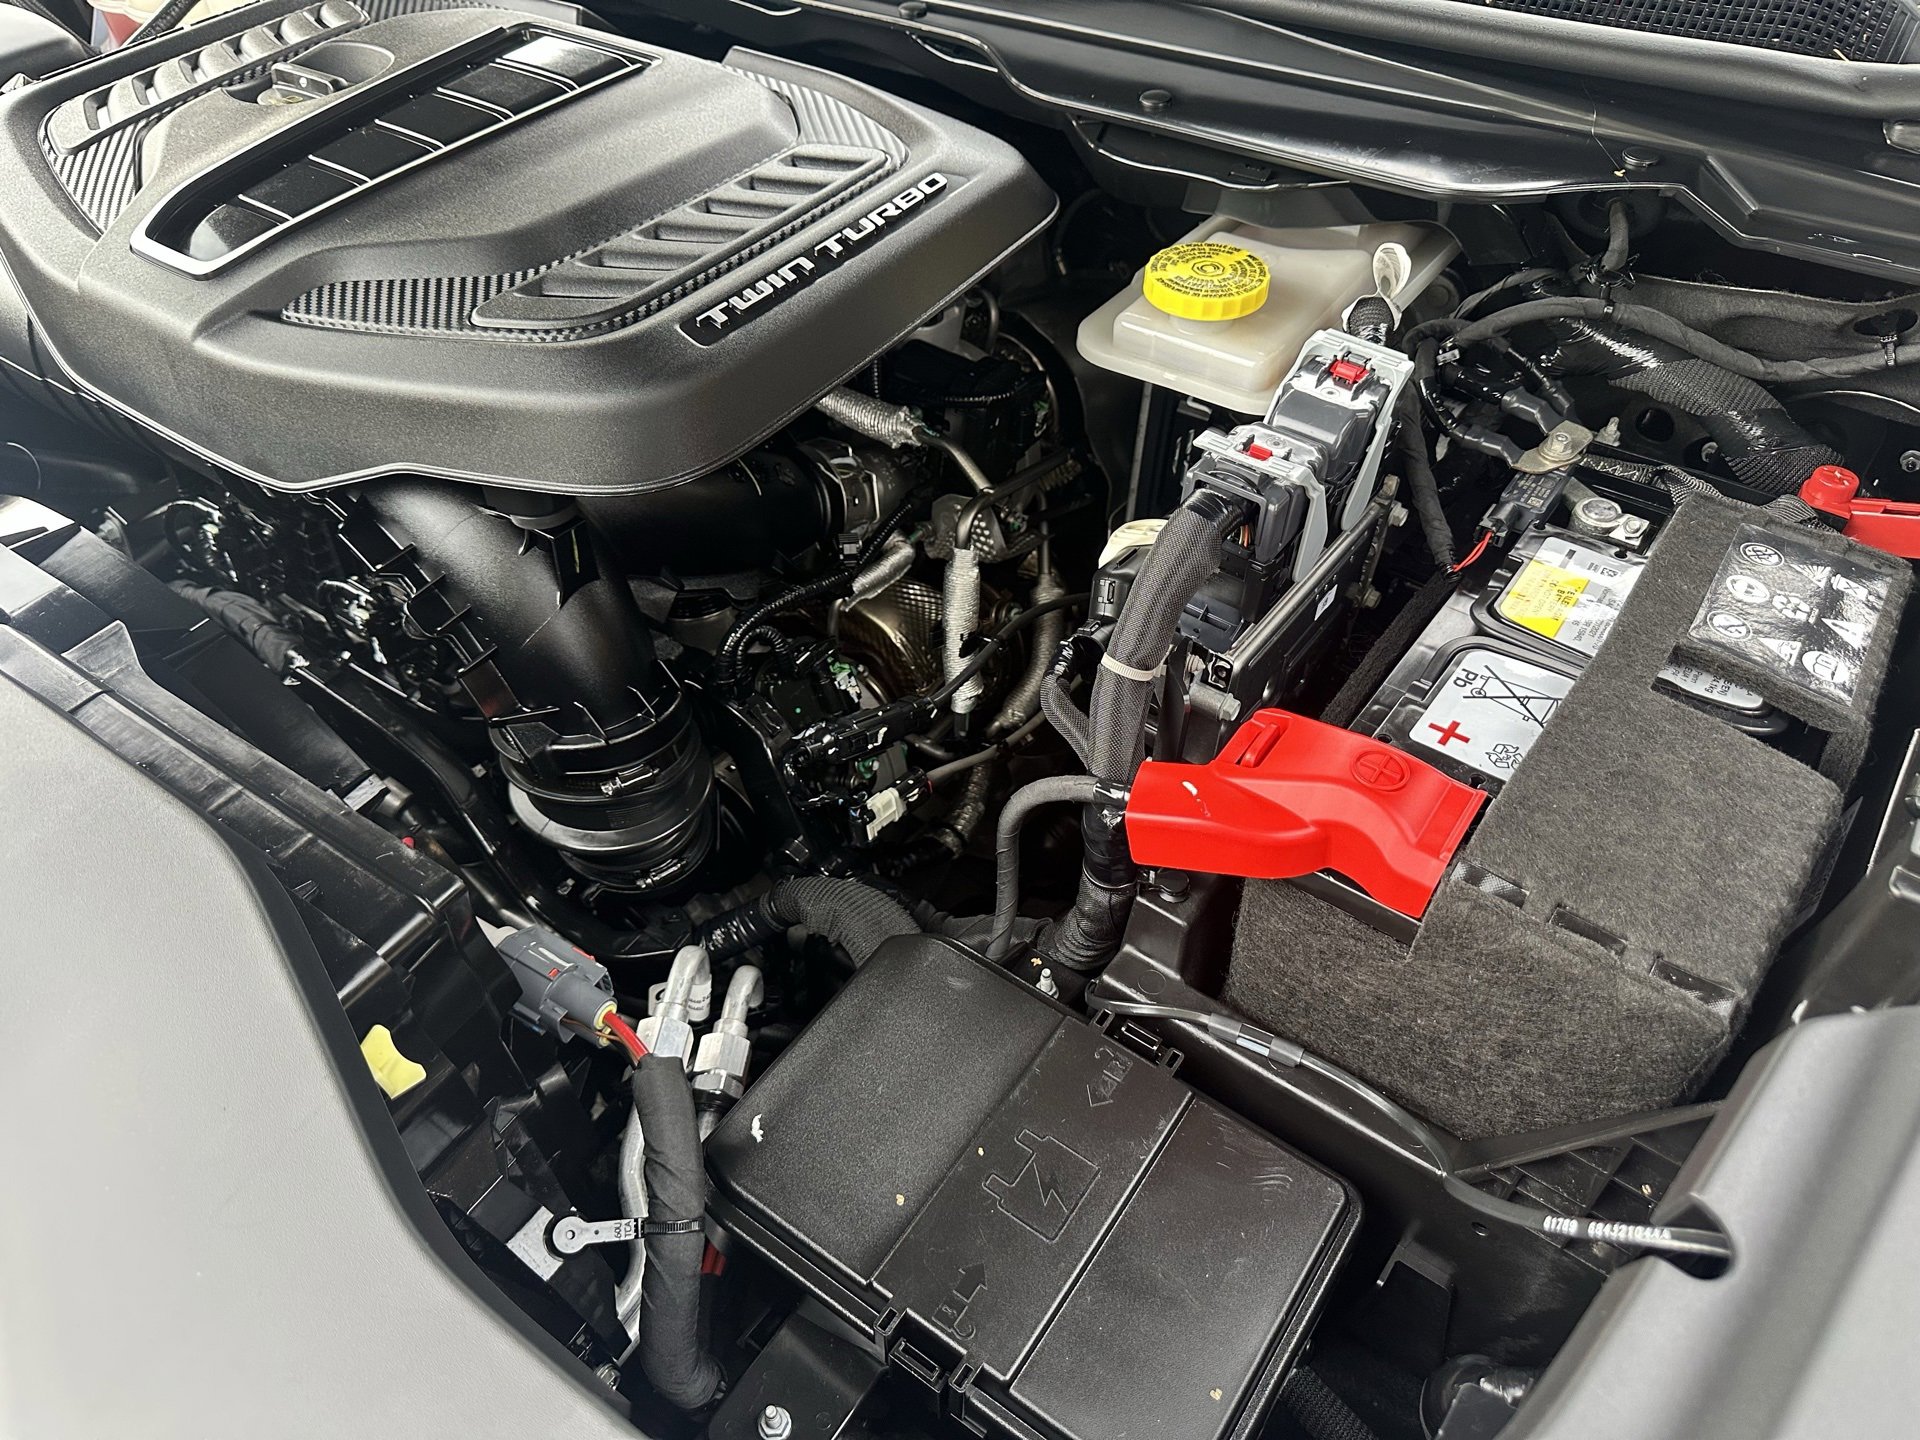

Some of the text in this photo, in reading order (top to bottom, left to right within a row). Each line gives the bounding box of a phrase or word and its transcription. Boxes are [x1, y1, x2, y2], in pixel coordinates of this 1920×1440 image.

[695, 171, 949, 329] TWIN TURBO
[1453, 667, 1479, 689] Pb
[623, 1220, 632, 1238] TCA
